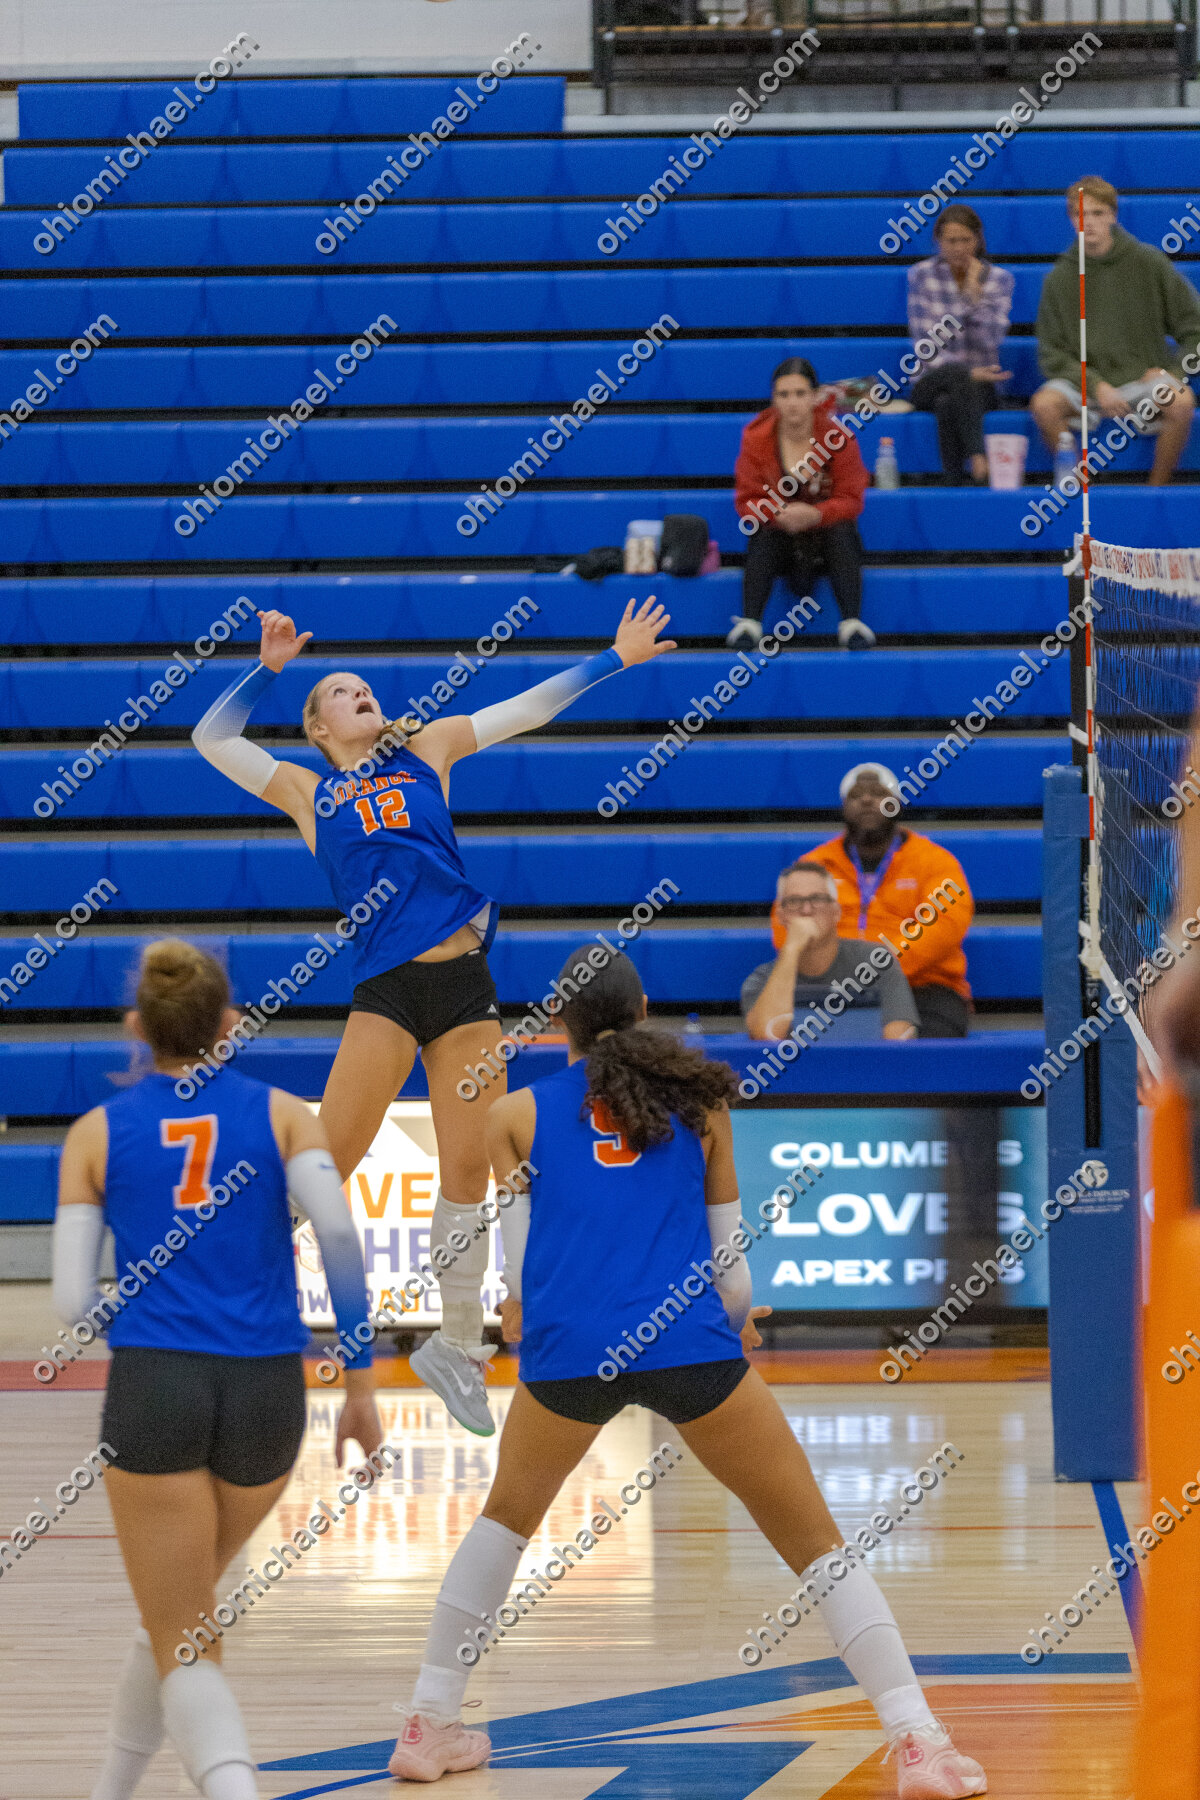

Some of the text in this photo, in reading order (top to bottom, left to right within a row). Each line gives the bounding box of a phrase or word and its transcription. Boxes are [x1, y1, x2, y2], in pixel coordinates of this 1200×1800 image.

[354, 788, 411, 837] 12
[159, 1113, 219, 1211] 7
[769, 1139, 1024, 1169] COLUMBS
[771, 1257, 1026, 1287] APEX PS
